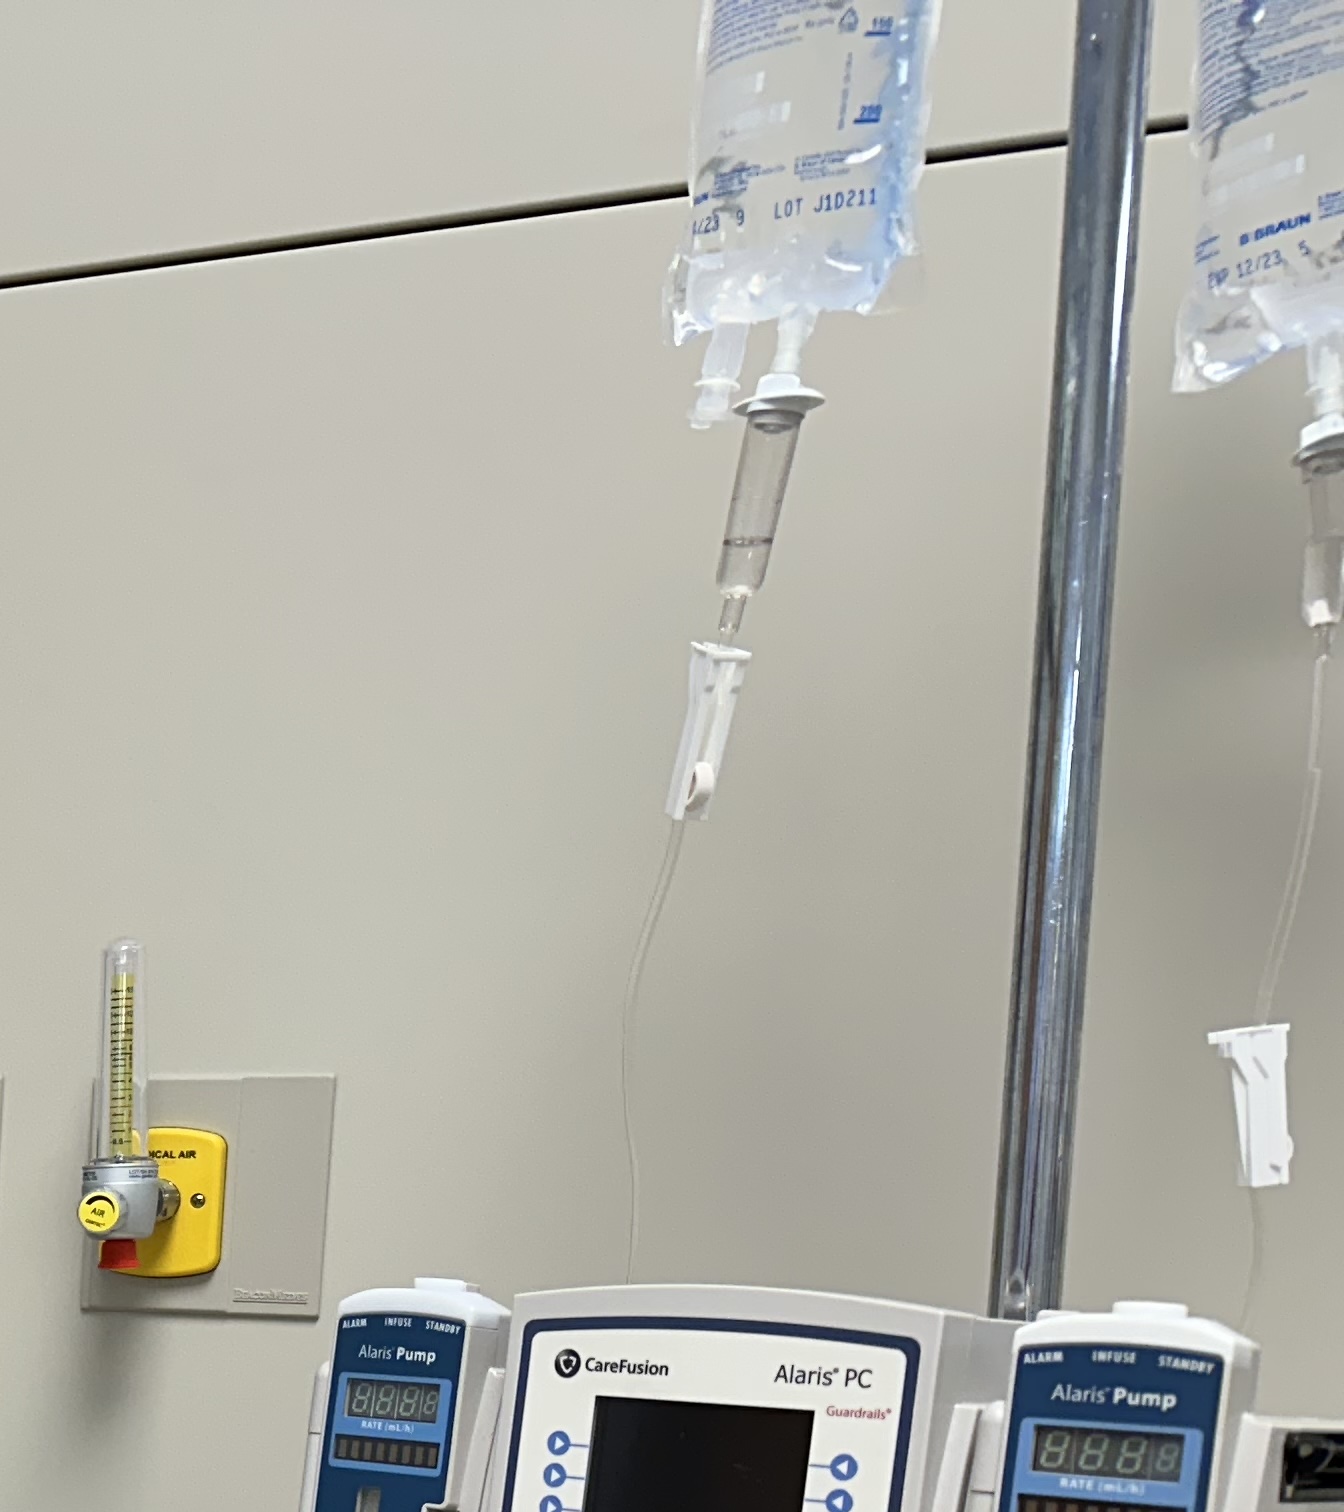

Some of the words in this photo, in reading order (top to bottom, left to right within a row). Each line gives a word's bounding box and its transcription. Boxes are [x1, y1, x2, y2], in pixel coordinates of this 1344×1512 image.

[773, 197, 803, 220] LOT
[814, 187, 877, 214] J1D211
[1254, 212, 1311, 242] BRAUN
[1236, 249, 1284, 279] 12/23
[178, 1150, 197, 1159] AIR
[90, 1207, 106, 1218] AIR
[342, 1317, 368, 1329] ALARM
[384, 1317, 412, 1328] INFUSE
[425, 1320, 462, 1336] STANDBY
[358, 1344, 393, 1361] Alaris
[396, 1346, 437, 1366] Pump
[1023, 1351, 1064, 1365] ALARM
[1091, 1350, 1137, 1365] INFUSE
[1157, 1354, 1215, 1375] STANDBY
[585, 1356, 670, 1378] CareFusion
[773, 1364, 836, 1387] Alaris
[844, 1368, 874, 1389] PC
[1050, 1383, 1107, 1404] Alaris
[1112, 1386, 1178, 1413] Pump
[826, 1404, 889, 1422] Guardrails
[360, 1420, 383, 1431] RATE
[384, 1421, 415, 1434] (mL/h)
[1059, 1477, 1094, 1491] RATE
[1097, 1480, 1146, 1495] (mL/h)
